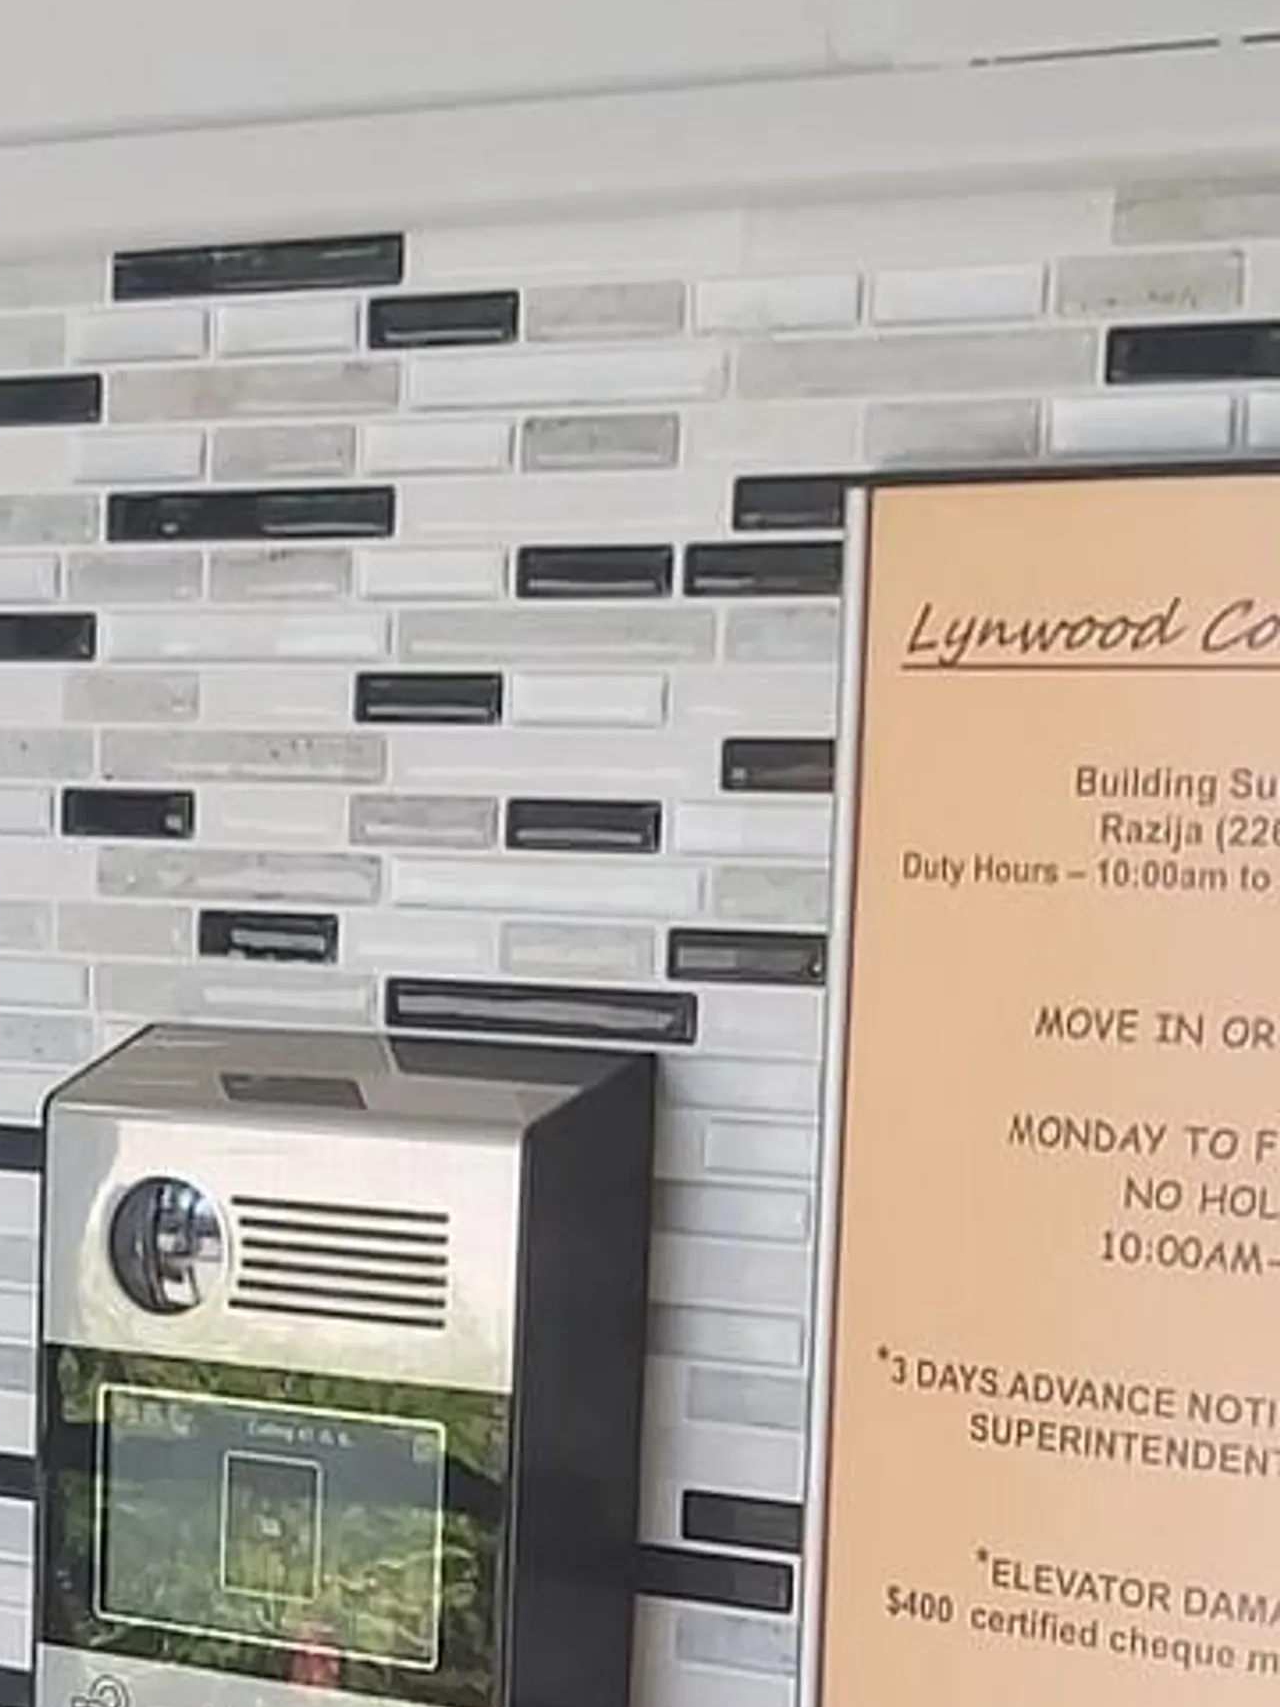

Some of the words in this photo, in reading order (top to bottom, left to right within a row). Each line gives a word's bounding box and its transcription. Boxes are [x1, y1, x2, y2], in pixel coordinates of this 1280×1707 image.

[907, 597, 1188, 667] Lynwood
[1075, 766, 1217, 806] Building
[1100, 812, 1203, 853] Razija
[902, 852, 965, 884] Duty
[974, 855, 1058, 885] Hours
[1097, 859, 1228, 891] 10:00am
[1240, 865, 1272, 893] to
[1034, 1006, 1139, 1044] MOVE
[1154, 1012, 1204, 1046] IN
[1222, 1015, 1276, 1050] OR
[1007, 1114, 1167, 1156] MONDAY
[1184, 1126, 1239, 1160] TO
[1123, 1178, 1182, 1211] NO
[1199, 1182, 1280, 1220] HOL
[917, 1358, 998, 1399] DAYS
[1010, 1372, 1176, 1421] ADVANCE
[885, 1585, 953, 1625] $400
[970, 1603, 1097, 1649] certified
[1109, 1623, 1235, 1672] cheque
